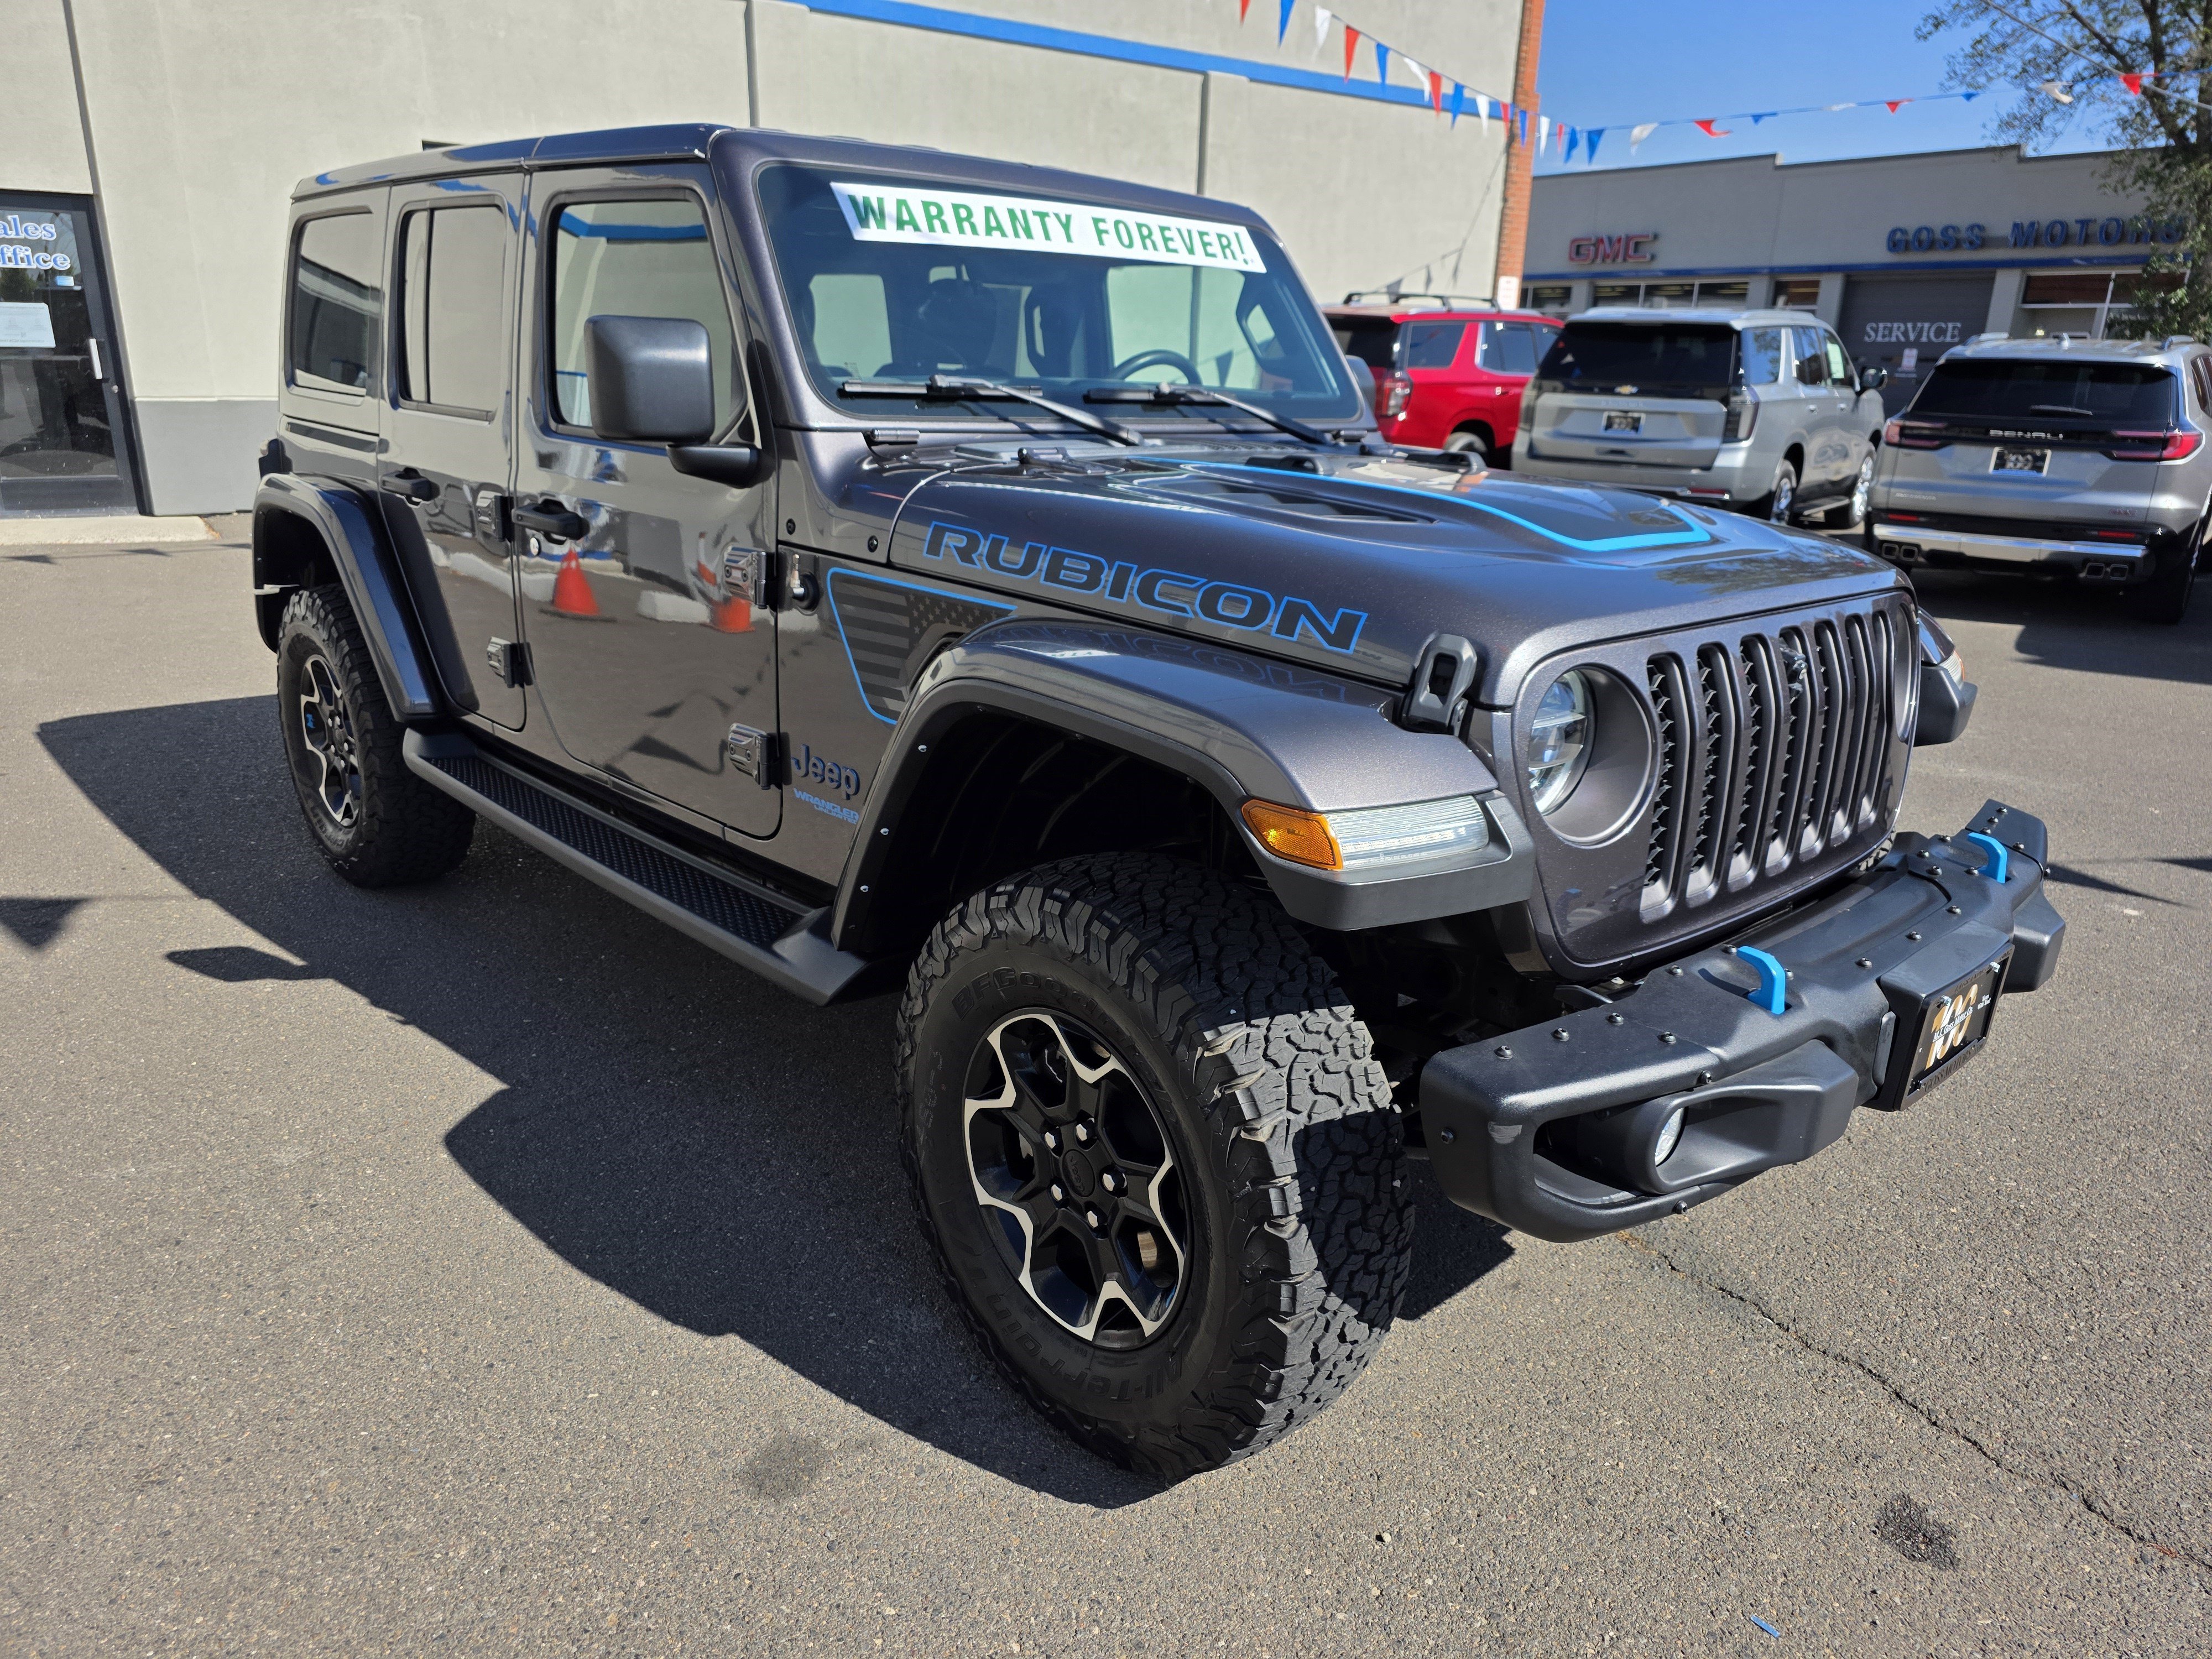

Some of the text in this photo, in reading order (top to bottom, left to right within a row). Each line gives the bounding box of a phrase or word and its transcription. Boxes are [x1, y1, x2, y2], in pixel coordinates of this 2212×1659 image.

[847, 194, 1249, 265] WARRANTY FOREVER!
[1886, 223, 1986, 253] GOSS
[1568, 233, 1655, 264] GMC
[1864, 321, 1962, 343] SERVICE
[923, 520, 1369, 654] RUBICON
[791, 744, 860, 800] Jeep
[794, 787, 859, 821] WRANGLER
